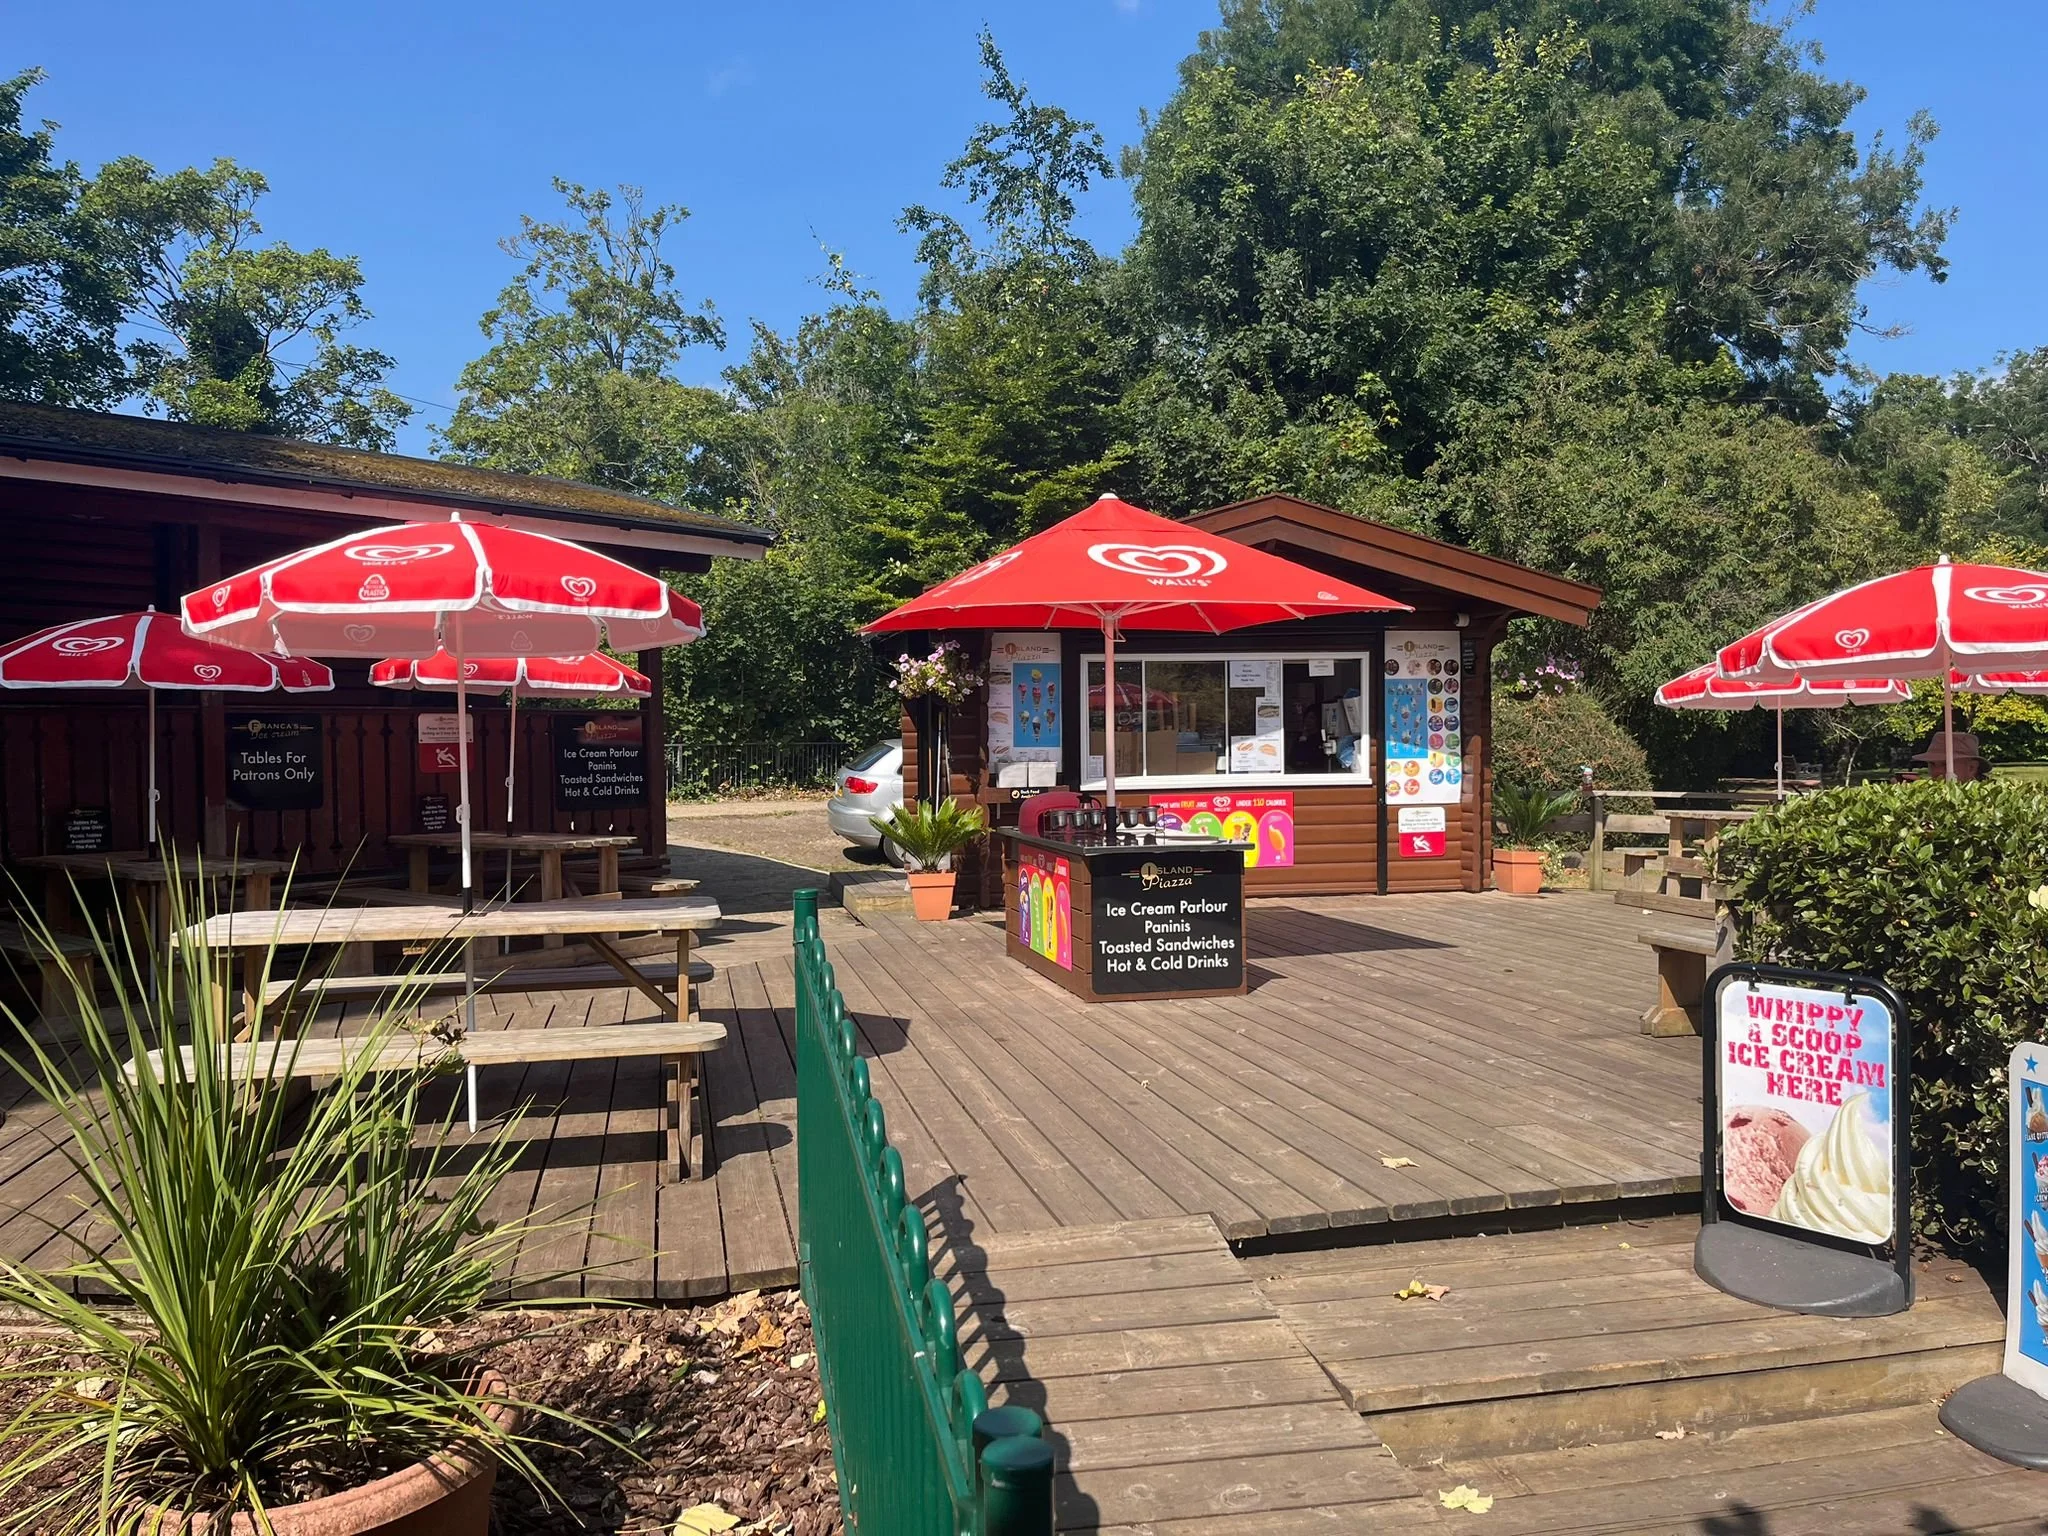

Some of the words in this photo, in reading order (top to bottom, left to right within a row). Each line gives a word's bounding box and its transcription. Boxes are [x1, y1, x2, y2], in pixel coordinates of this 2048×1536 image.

[1146, 578, 1208, 587] WALL'S
[248, 720, 299, 732] FRANCA'S
[241, 751, 282, 764] Tables
[286, 751, 306, 763] For
[564, 748, 576, 758] Ice
[579, 748, 607, 758] Cream
[610, 748, 638, 757] Parlour
[588, 761, 616, 770] Paninis
[233, 769, 280, 780] Patrons
[284, 767, 314, 782] Only
[560, 774, 593, 784] Toasted
[595, 772, 643, 783] Sandwiches
[565, 788, 580, 797] Hot
[583, 787, 590, 796] &
[592, 786, 612, 796] Cold
[615, 785, 639, 795] Drinks
[1143, 864, 1193, 878] ISLAND
[1142, 875, 1193, 891] Piazza
[1106, 904, 1126, 917] Ice
[1131, 902, 1175, 916] Cream
[1180, 899, 1228, 913] Parlour
[1145, 920, 1191, 934] Paninis
[1099, 938, 1152, 954] Toasted
[1156, 935, 1235, 950] Sandwiches
[1107, 959, 1131, 973] Hot
[1136, 958, 1146, 971] &
[1151, 955, 1183, 970] Cold
[1188, 953, 1228, 969] Drinks
[1746, 995, 1864, 1031] WHIPPY
[1748, 1024, 1762, 1043] &
[1771, 1024, 1862, 1057] SCOOP
[1728, 1041, 1769, 1069] ICE
[1780, 1050, 1885, 1088] CREAM
[1767, 1072, 1842, 1106] HERE
